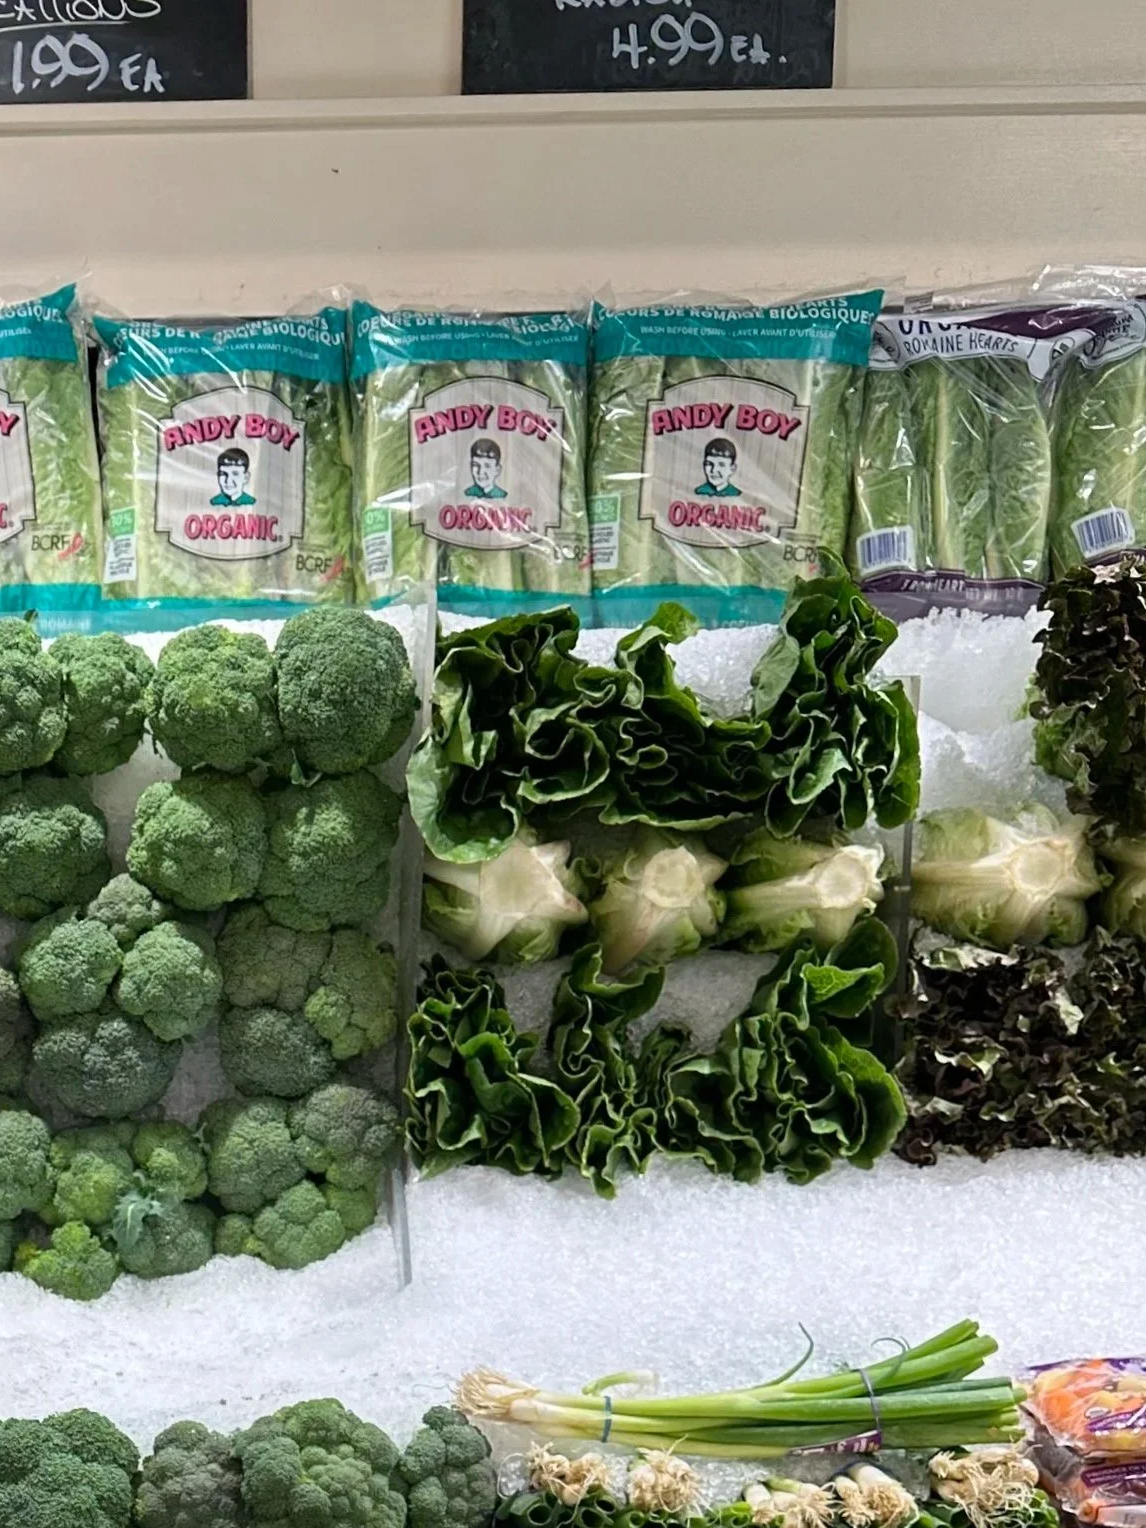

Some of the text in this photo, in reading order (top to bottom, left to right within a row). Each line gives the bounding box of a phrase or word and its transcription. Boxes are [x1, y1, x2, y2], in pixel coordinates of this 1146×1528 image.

[612, 11, 723, 69] 4.99
[119, 53, 166, 93] EA
[166, 328, 188, 339] DE
[640, 325, 666, 335] WASH
[761, 328, 787, 337] AVANT
[969, 332, 1018, 353] HEARTS
[164, 413, 301, 450] ANDY BOY
[415, 405, 556, 443] ANDY BOY
[653, 402, 801, 439] ANDY BOY
[183, 514, 278, 541] ORGANIC
[439, 505, 533, 533] ORGANIC
[667, 502, 764, 532] ORGANIC
[31, 534, 71, 552] BCRF
